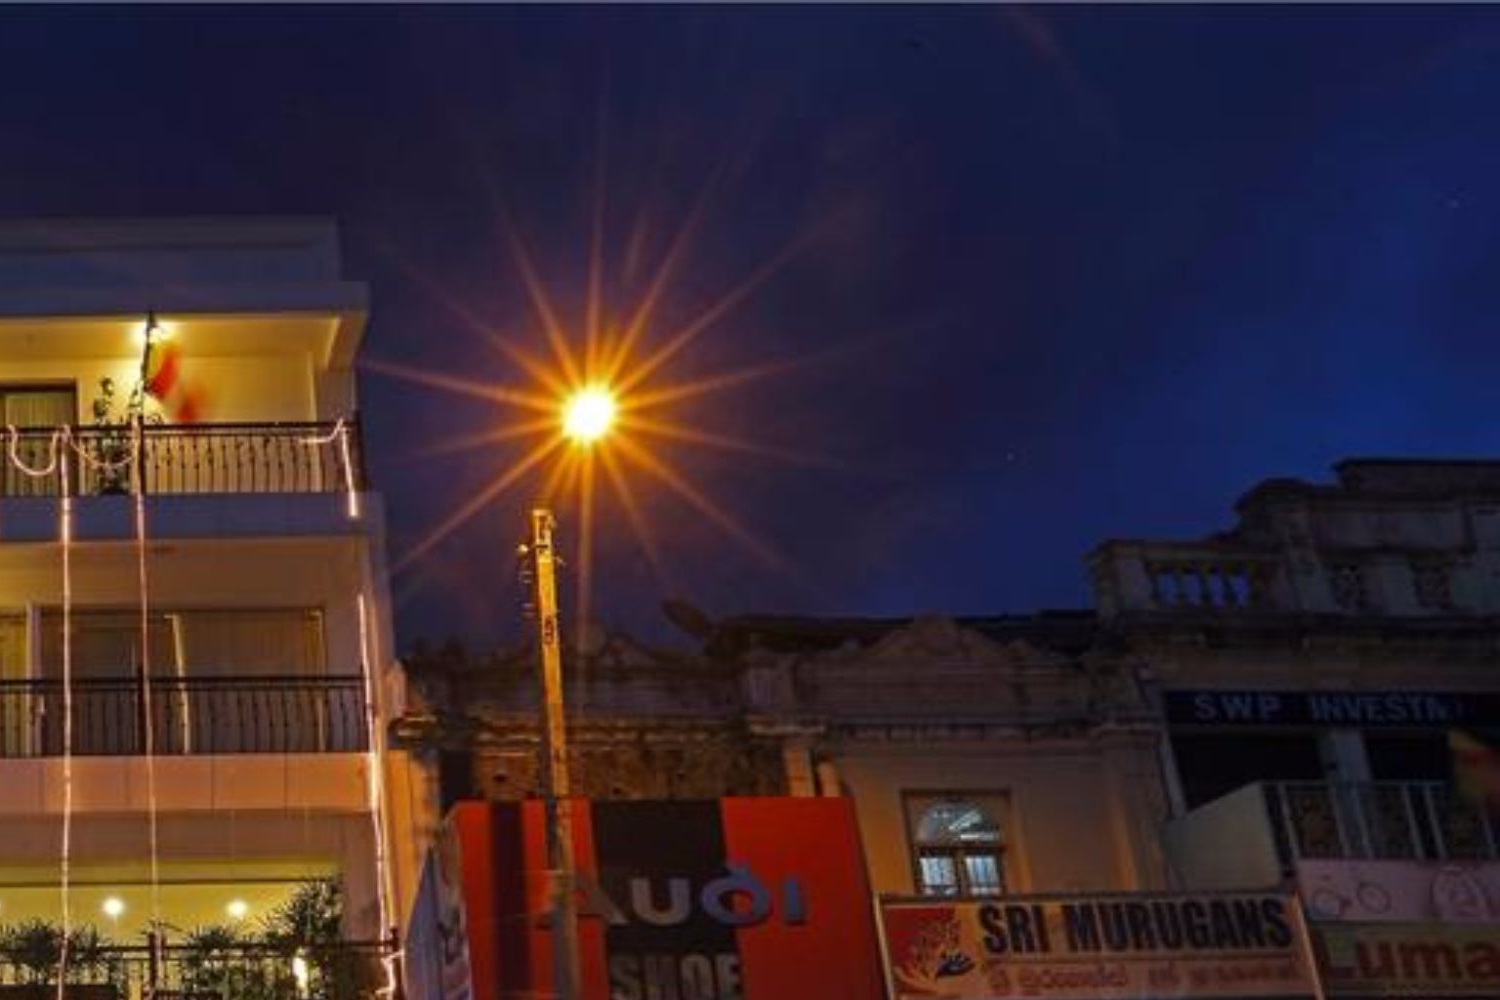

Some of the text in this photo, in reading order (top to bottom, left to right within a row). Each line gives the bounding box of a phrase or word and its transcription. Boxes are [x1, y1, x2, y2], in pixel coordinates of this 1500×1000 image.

[1195, 693, 1282, 722] SWP
[980, 900, 1293, 954] SRI MURUGANS
